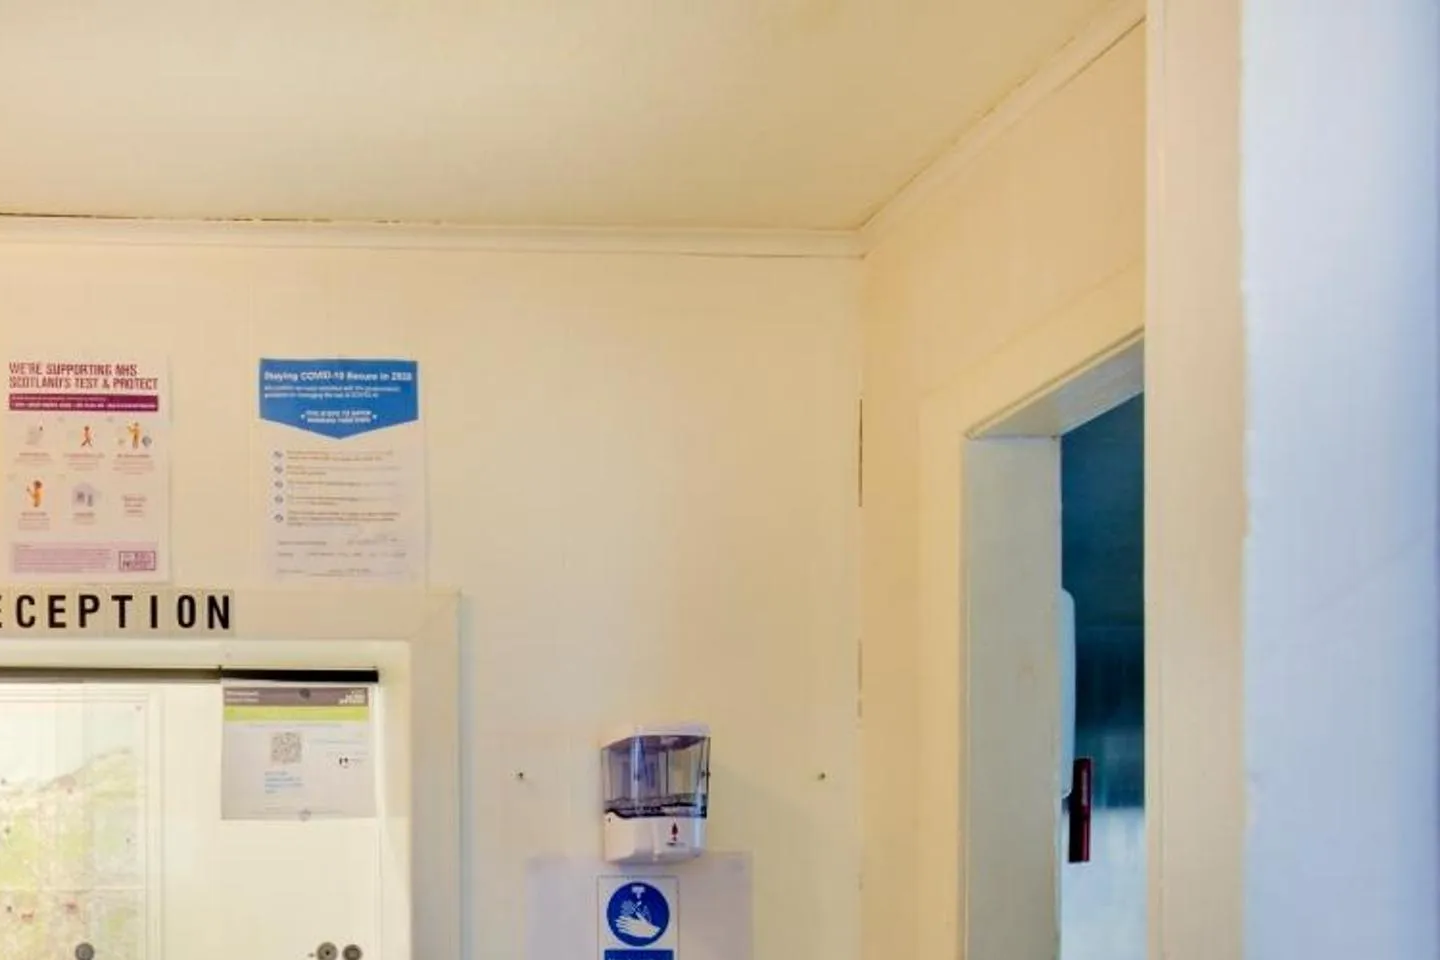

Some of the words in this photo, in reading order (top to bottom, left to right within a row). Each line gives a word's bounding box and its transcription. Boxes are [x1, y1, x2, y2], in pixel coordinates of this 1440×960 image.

[46, 363, 112, 376] SUPPORTING
[115, 364, 137, 376] NHS
[9, 375, 72, 389] SCOTLAND'S
[74, 377, 99, 389] TEST
[113, 378, 158, 390] PROTECT
